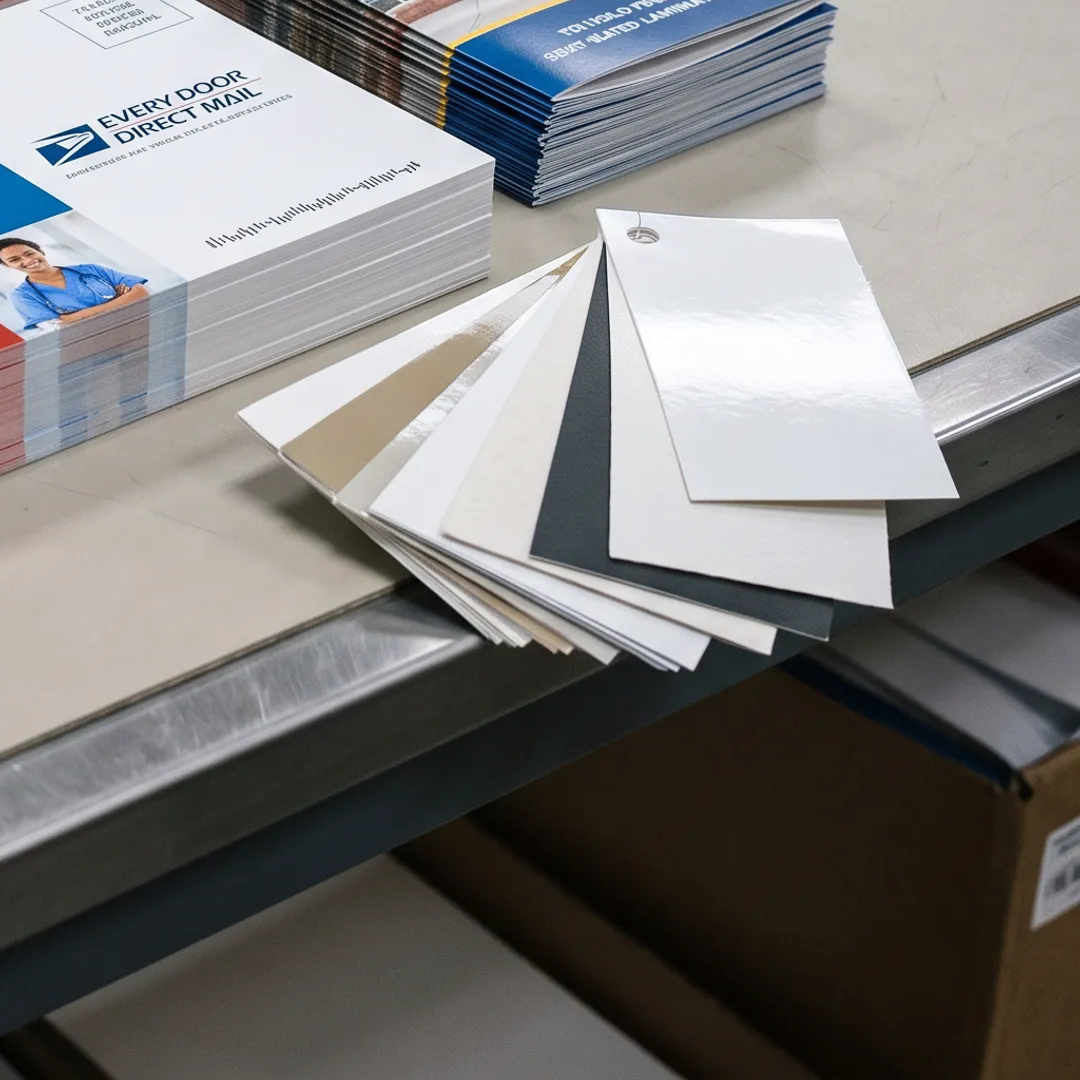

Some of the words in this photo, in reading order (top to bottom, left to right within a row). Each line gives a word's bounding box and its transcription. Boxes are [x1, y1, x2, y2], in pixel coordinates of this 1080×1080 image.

[97, 94, 171, 129] EVERY
[174, 69, 248, 101] DOOR
[113, 106, 198, 145] DIRECT
[200, 87, 262, 114] MAIL
